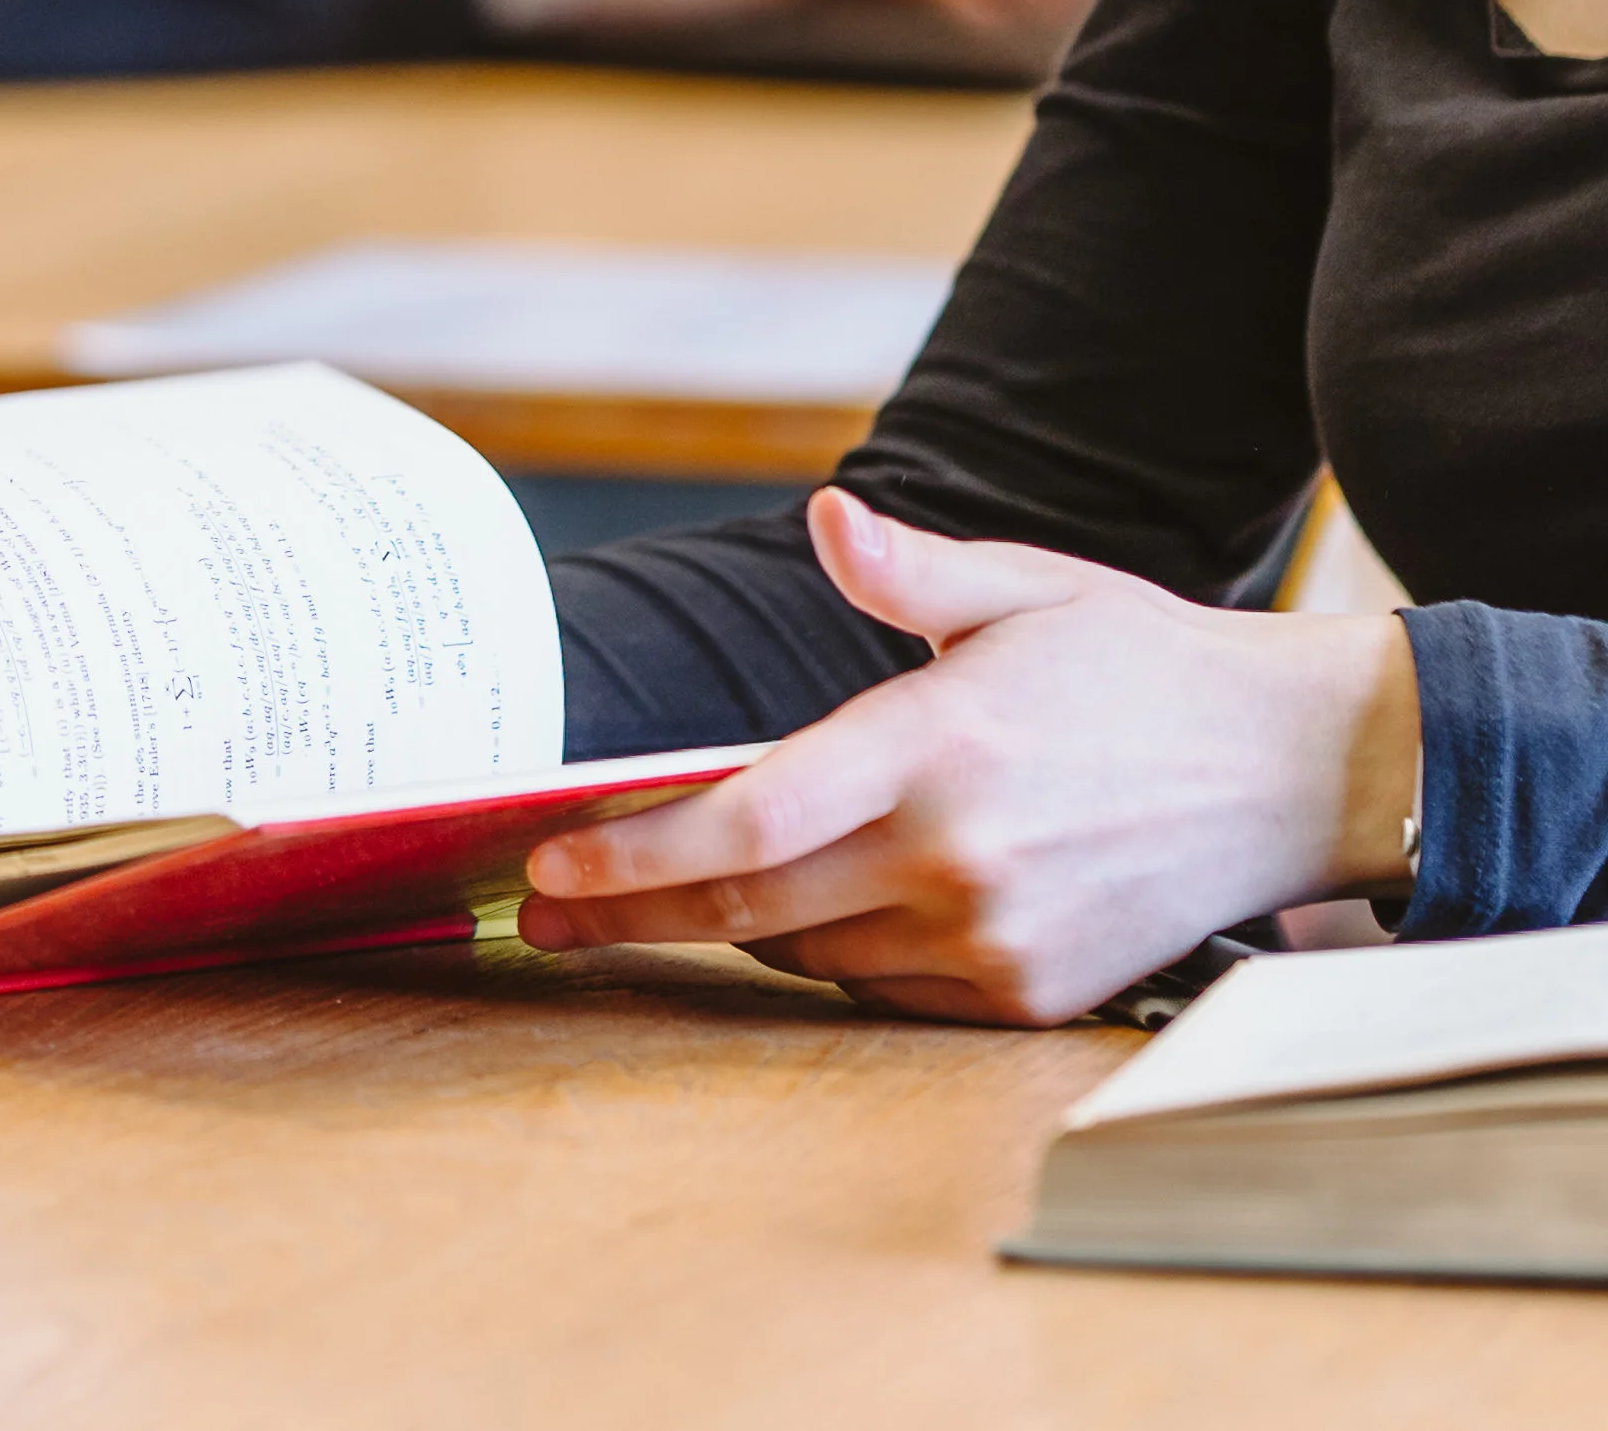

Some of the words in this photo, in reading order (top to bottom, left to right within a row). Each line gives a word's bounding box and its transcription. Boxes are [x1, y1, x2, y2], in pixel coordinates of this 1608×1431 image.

[15, 534, 38, 555] and
[59, 529, 74, 543] let
[8, 577, 23, 590] of
[97, 593, 123, 647] formula
[301, 594, 319, 619] and
[51, 624, 60, 633] a
[59, 601, 79, 648] Verma
[120, 610, 144, 664] identity
[54, 637, 64, 647] is
[74, 655, 90, 682] and
[52, 681, 59, 690] a
[67, 680, 81, 719] while
[119, 654, 141, 741] summation
[135, 672, 158, 716] [1748]
[52, 698, 64, 710] is
[85, 688, 98, 720] Jain
[90, 727, 105, 759] (See
[146, 723, 160, 776] Euler's
[365, 722, 375, 753] that
[61, 747, 73, 779] that
[222, 738, 233, 771] that
[134, 780, 144, 804] the
